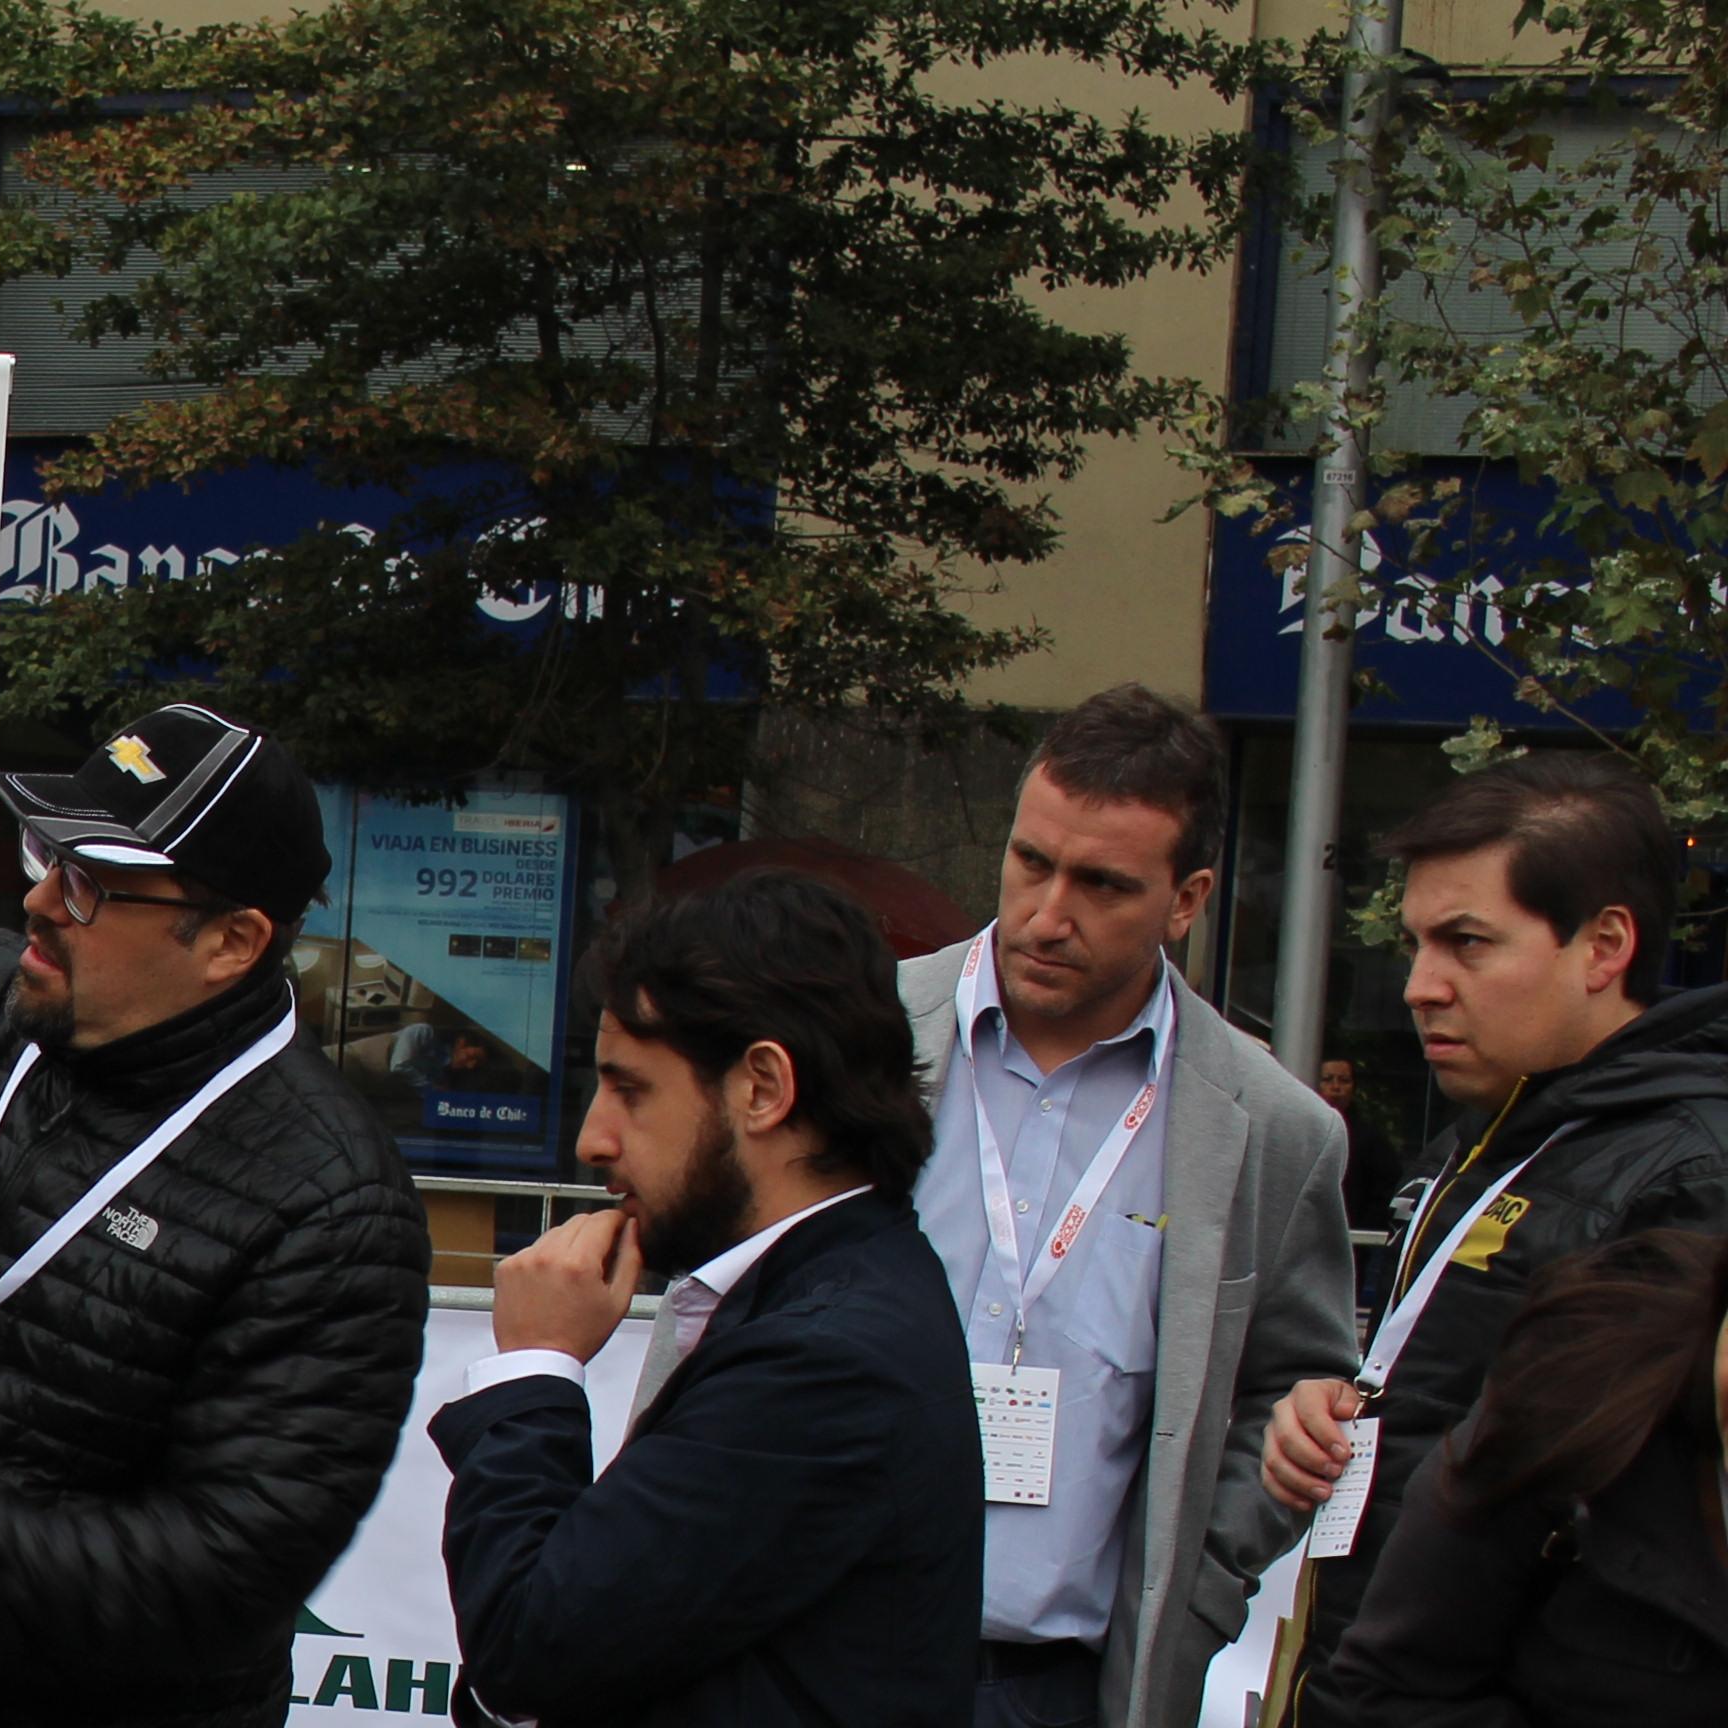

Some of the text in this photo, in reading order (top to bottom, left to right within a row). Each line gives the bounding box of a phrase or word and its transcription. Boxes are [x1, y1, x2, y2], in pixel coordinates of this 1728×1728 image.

[371, 833, 557, 858] VIAJA EN BUSINESS
[1323, 843, 1336, 870] 2
[416, 867, 555, 897] 992 DOLARES
[492, 886, 554, 901] PREMIO
[437, 1101, 475, 1118] Banco
[479, 1105, 492, 1119] de
[101, 1205, 141, 1236] NORTH
[127, 1205, 150, 1228] THE
[106, 1222, 138, 1246] FACE
[290, 1655, 452, 1716] AH
